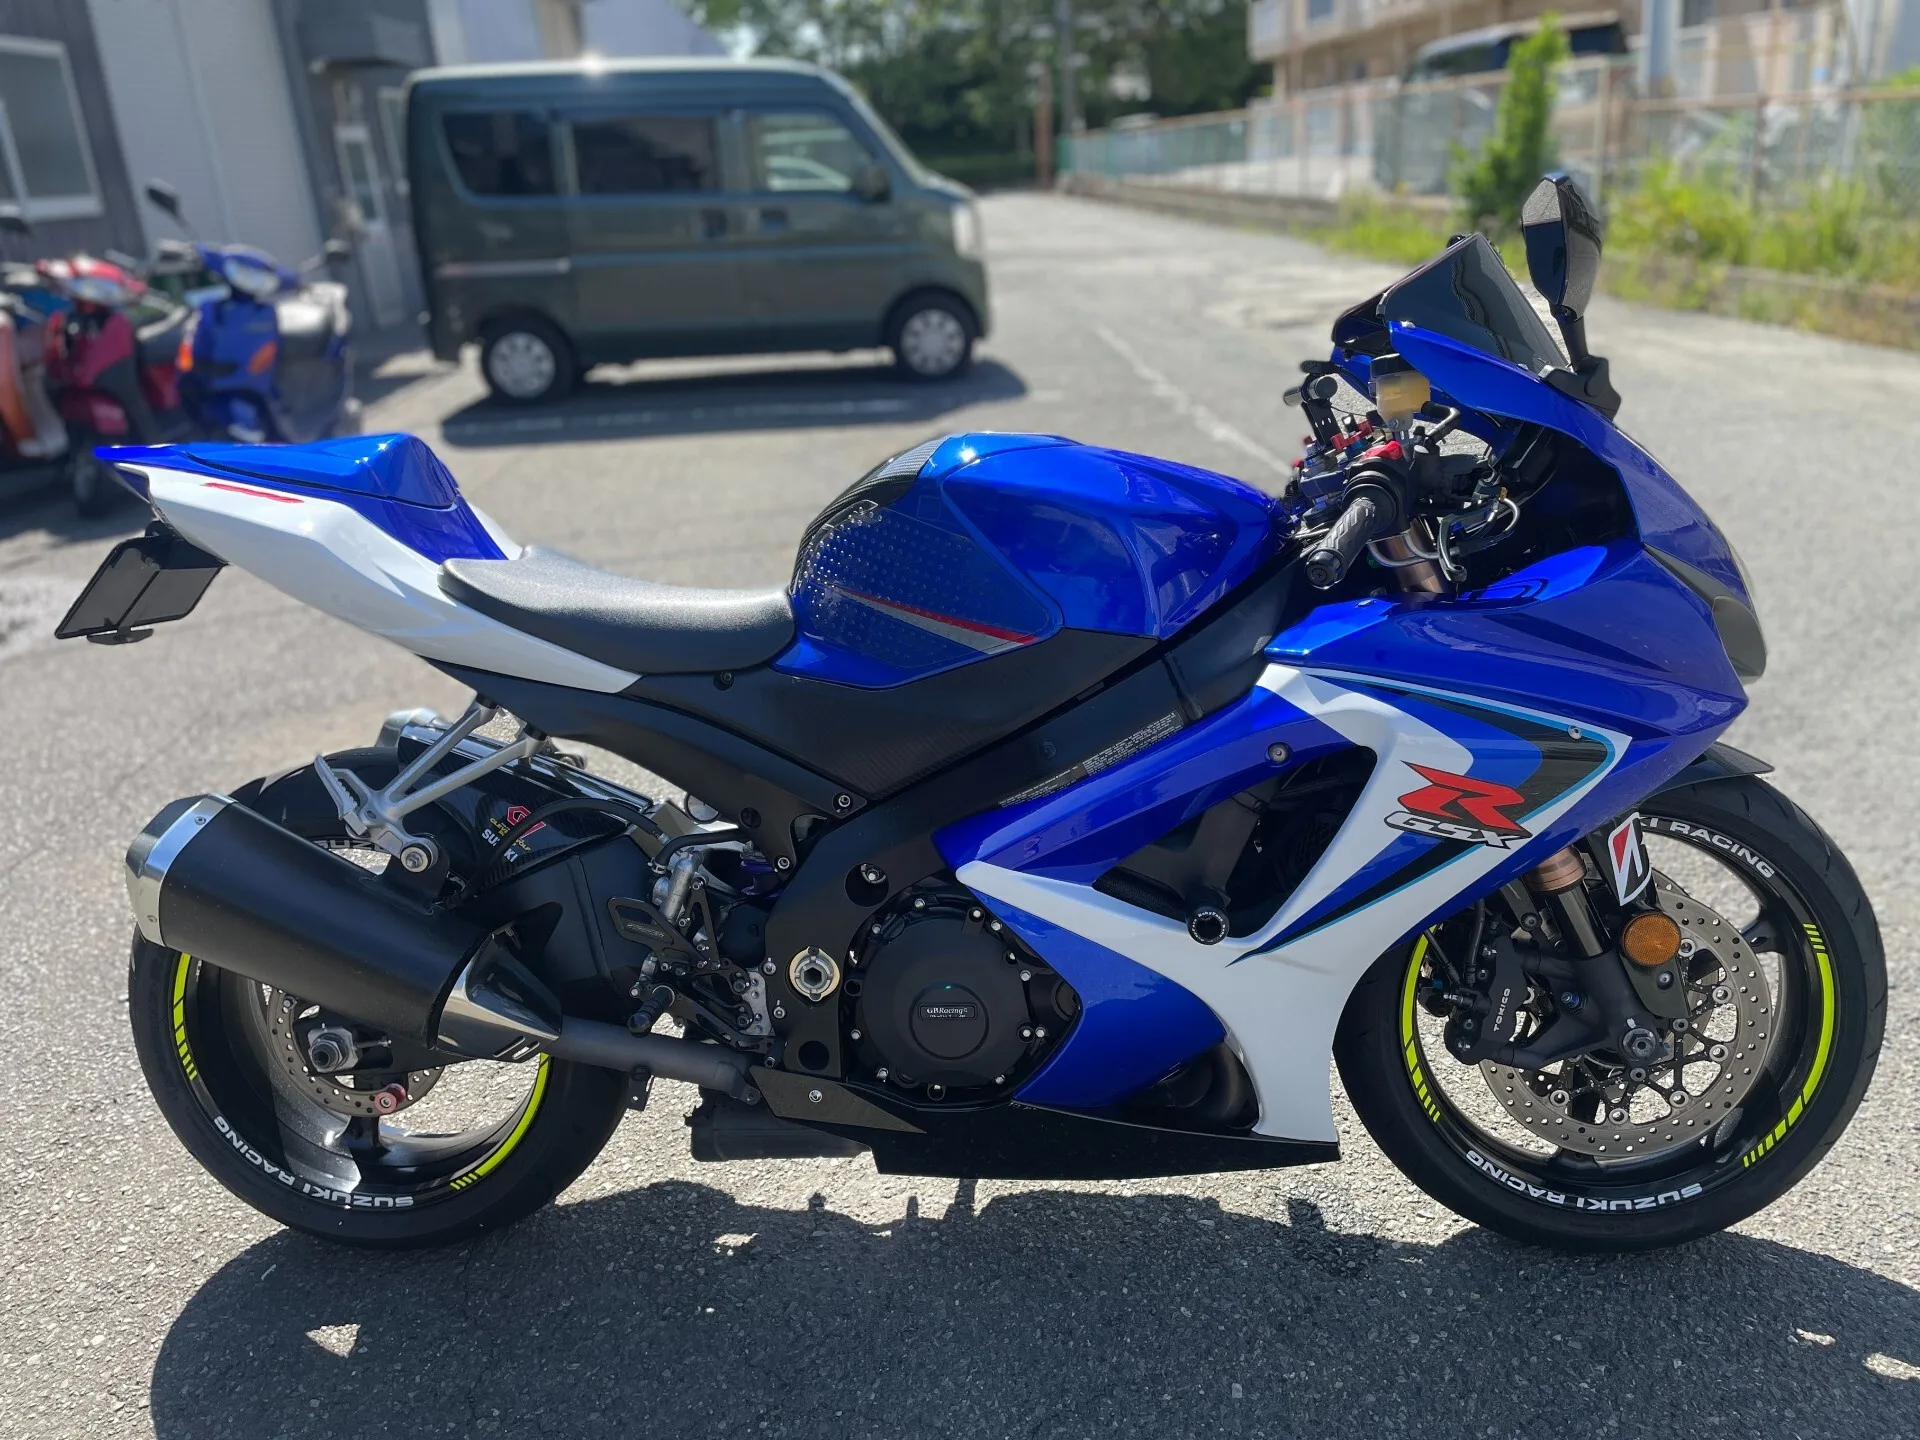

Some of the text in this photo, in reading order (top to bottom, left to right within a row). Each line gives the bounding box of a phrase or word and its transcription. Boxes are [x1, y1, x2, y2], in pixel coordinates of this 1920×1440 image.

[481, 828, 519, 863] SUKI
[1386, 811, 1520, 849] GSX
[1670, 821, 1775, 879] RACING
[1493, 988, 1511, 1032] TOKICO
[213, 1115, 414, 1208] SUZUKI RACING
[1466, 1150, 1703, 1211] SUZUKI RACING
